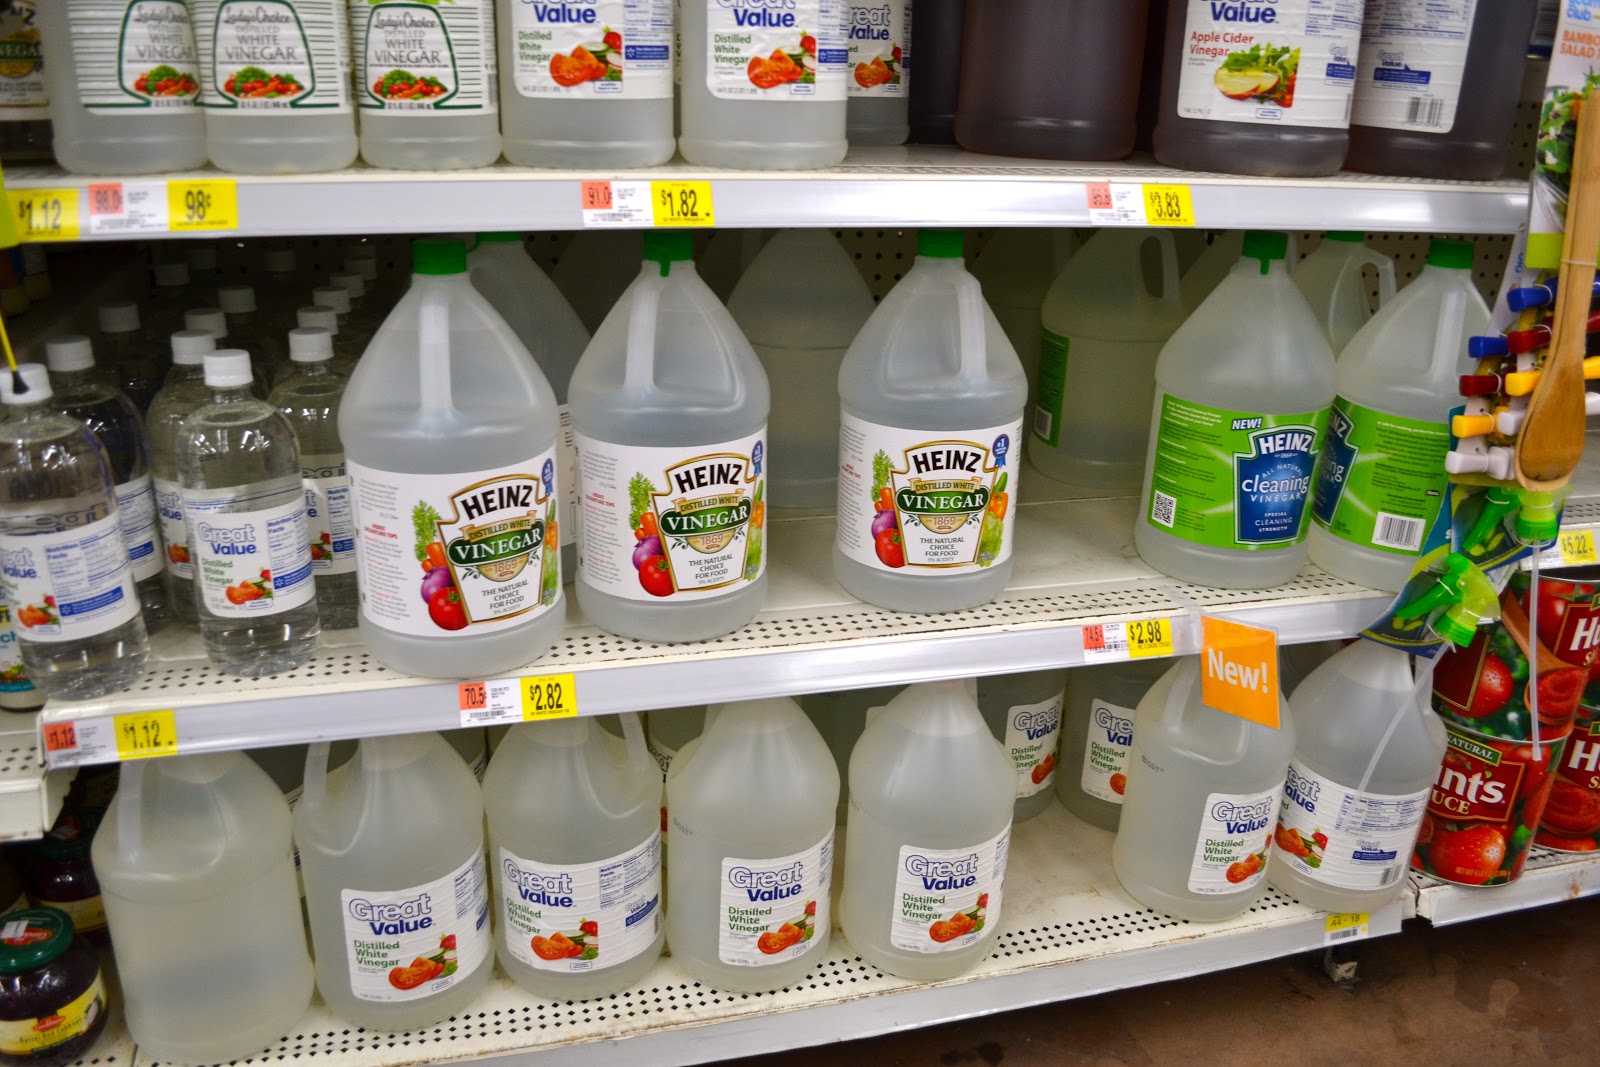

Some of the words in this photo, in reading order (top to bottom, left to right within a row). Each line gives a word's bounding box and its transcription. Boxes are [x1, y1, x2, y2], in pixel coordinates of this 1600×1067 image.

[534, 3, 597, 23] Value
[733, 8, 796, 27] Value
[1211, 2, 1277, 23] Value
[236, 34, 280, 45] WHITE
[518, 31, 552, 40] Distilled
[714, 34, 752, 44] Distilled
[1190, 31, 1221, 44] Apple
[1223, 33, 1255, 43] Cider
[384, 39, 425, 49] WHITE
[519, 42, 542, 50] White
[714, 45, 740, 54] White
[1560, 43, 1596, 58] SALAD
[224, 46, 298, 60] VINEGAR
[374, 51, 442, 63] VINEGAR
[519, 52, 551, 63] Vinegar
[1190, 45, 1230, 58] Vinegar
[714, 55, 750, 66] Vinegar
[661, 188, 699, 217] $1.82
[1232, 418, 1262, 430] NEW!
[1258, 432, 1313, 455] HEINZ
[912, 450, 982, 474] HEINZ
[674, 463, 743, 494] HEINZ
[1242, 474, 1310, 494] cleaning
[915, 481, 952, 491] DISTILLED
[953, 482, 975, 490] WHITE
[461, 485, 533, 520] HEINZ
[680, 498, 717, 512] DISTILLED
[718, 495, 740, 505] WHITE
[902, 493, 985, 509] VINEGAR
[1250, 492, 1302, 503] VINEGAR
[160, 508, 182, 520] alue
[666, 505, 748, 531] VINEGAR
[933, 516, 956, 526] 1869
[1255, 517, 1293, 526] CLEANING
[199, 522, 257, 544] Great
[469, 522, 508, 540] DISTILLED
[509, 519, 531, 531] WHITE
[454, 528, 542, 560] VINEGAR
[700, 534, 724, 545] 1869
[1562, 535, 1588, 555] $5.22
[211, 542, 257, 556] Value
[202, 557, 234, 569] Distilled
[492, 560, 517, 573] 1869
[703, 554, 733, 565] NATURAL
[203, 567, 225, 577] White
[699, 563, 724, 572] CHOICE
[710, 568, 728, 577] FOOD
[204, 575, 234, 586] Vinegar
[481, 589, 497, 597] THE
[498, 579, 528, 594] NATURAL
[489, 600, 504, 609] FOR
[505, 595, 525, 606] FOOD
[493, 591, 520, 602] CHOICE
[1129, 620, 1162, 644] $2.98
[1208, 648, 1269, 694] New!
[529, 682, 563, 711] $2.82
[1013, 701, 1060, 731] Great
[1095, 707, 1134, 735] Gre
[1026, 720, 1059, 741] Value
[1107, 730, 1133, 747] Val
[1012, 742, 1043, 755] Distilled
[1091, 741, 1126, 758] Distilled
[1090, 749, 1115, 763] White
[1014, 758, 1041, 769] inegar
[1090, 756, 1122, 772] Vinegar
[1287, 765, 1321, 802] reat
[1431, 789, 1472, 815] UCE
[1212, 796, 1273, 823] Great
[1226, 816, 1268, 834] Value
[1205, 838, 1244, 848] Distilled
[1205, 846, 1233, 856] White
[905, 853, 979, 878] Great
[1203, 854, 1239, 864] Vinegar
[503, 858, 573, 894] Great
[728, 861, 803, 889] Great
[922, 875, 976, 891] Value
[518, 885, 574, 908] Value
[747, 884, 802, 902] Value
[902, 892, 946, 904] Distilled
[349, 893, 432, 922] Great
[506, 897, 542, 919] Distilled
[728, 906, 772, 916] Distilled
[902, 900, 934, 912] White
[507, 906, 532, 923] White
[729, 915, 760, 924] White
[902, 909, 943, 922] Vinegar
[1330, 917, 1342, 927] A4
[1350, 914, 1361, 923] 18
[370, 916, 433, 936] Value
[508, 914, 541, 934] Vinegar
[728, 923, 770, 934] Vinegar
[354, 940, 400, 949] Distilled
[355, 948, 388, 959] White
[356, 956, 401, 969] Vinegar
[43, 1030, 55, 1039] Red
